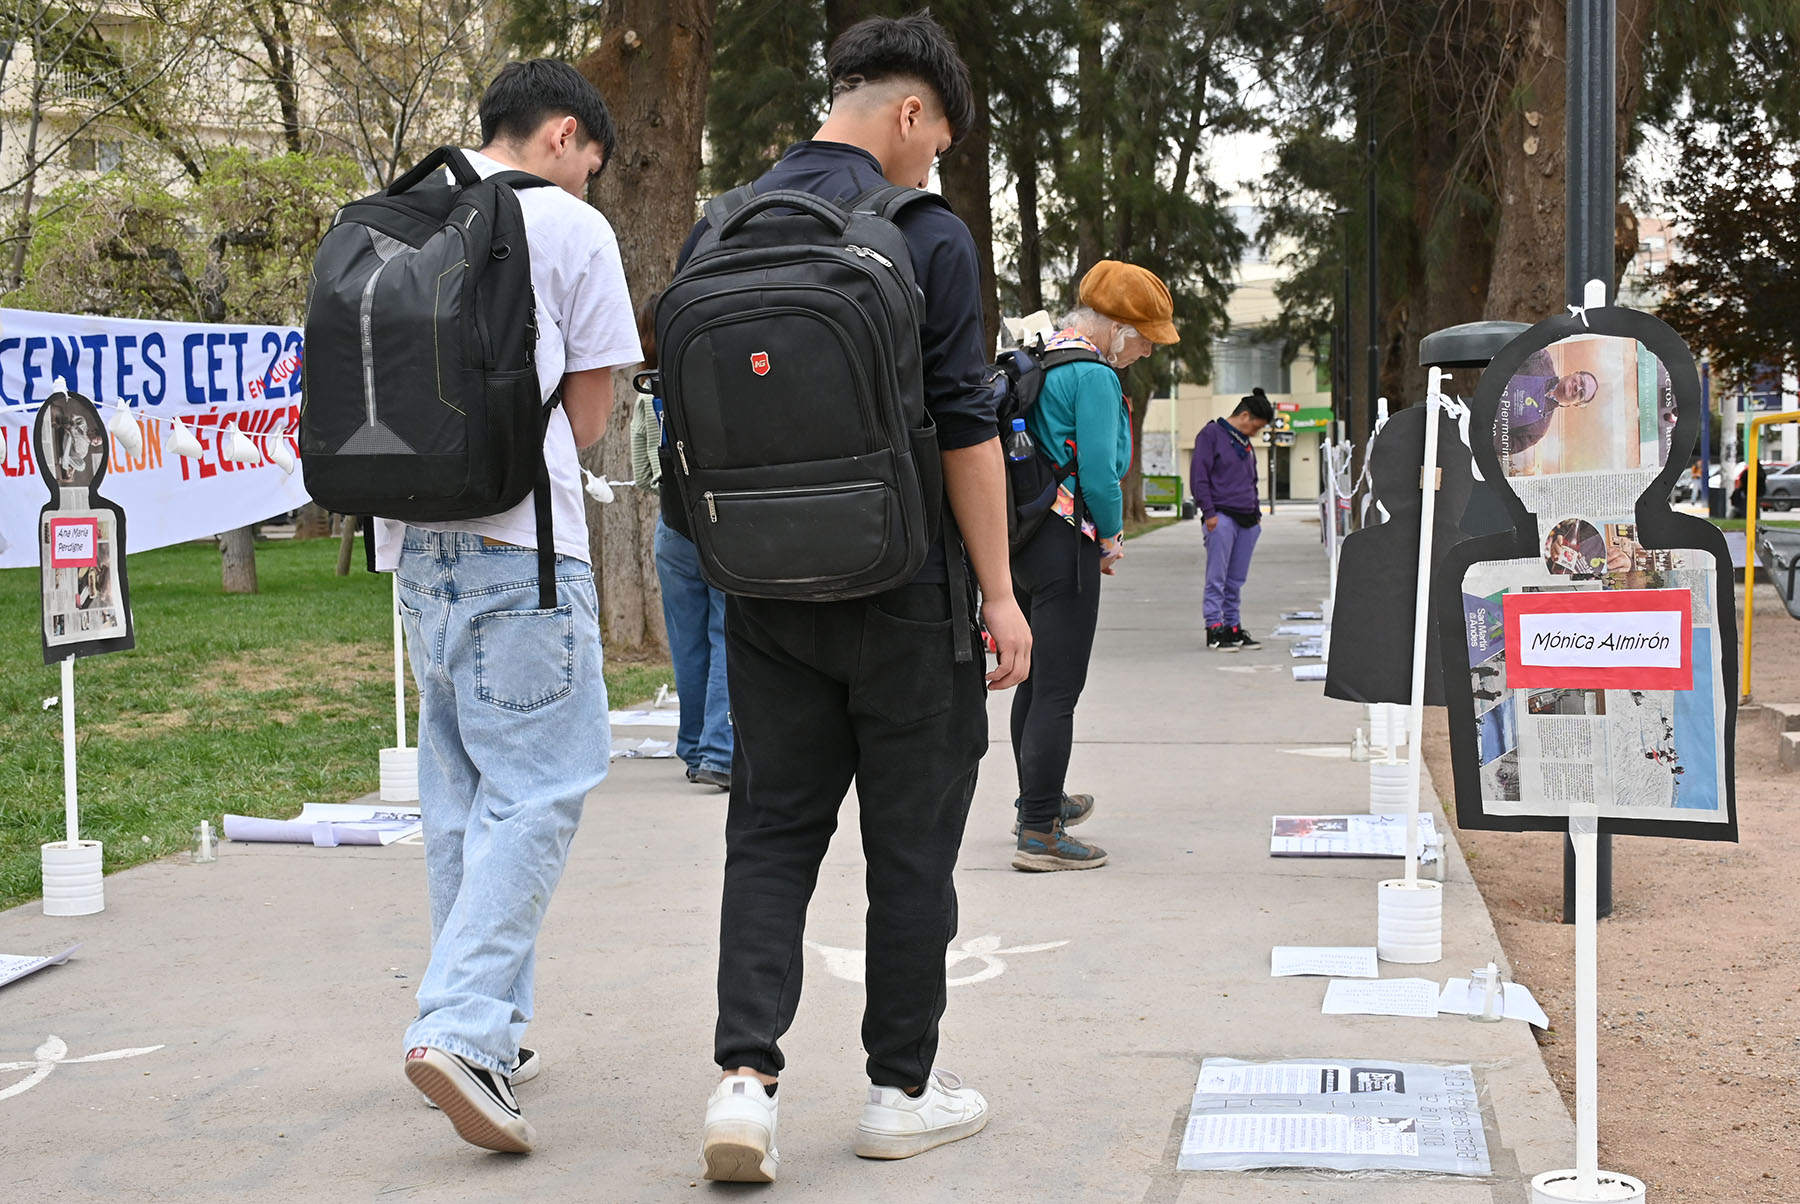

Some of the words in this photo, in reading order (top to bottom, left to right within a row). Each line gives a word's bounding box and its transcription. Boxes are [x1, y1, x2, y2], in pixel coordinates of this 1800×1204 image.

[183, 332, 248, 404] CET
[269, 351, 303, 383] LUCH
[58, 528, 71, 538] Ana
[1477, 608, 1486, 625] San
[1470, 620, 1478, 647] Andes
[1531, 631, 1595, 651] Mónica
[1597, 631, 1670, 651] Almirón
